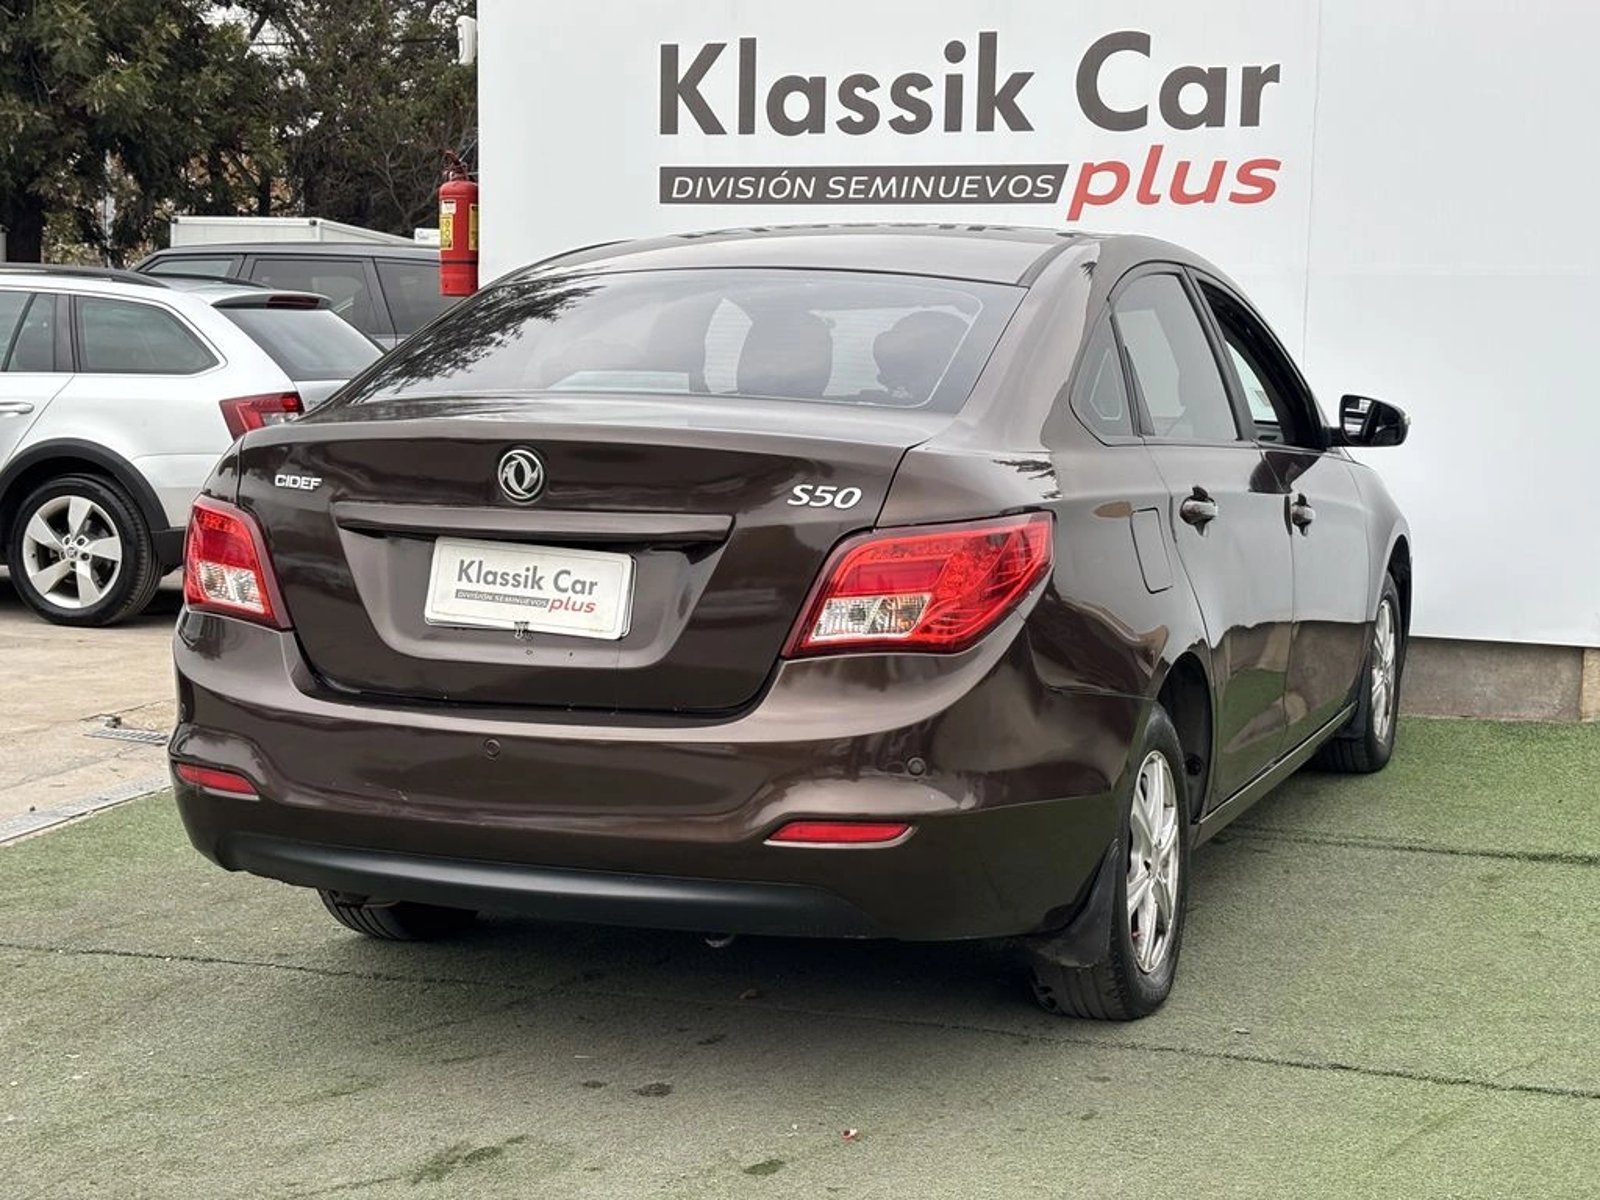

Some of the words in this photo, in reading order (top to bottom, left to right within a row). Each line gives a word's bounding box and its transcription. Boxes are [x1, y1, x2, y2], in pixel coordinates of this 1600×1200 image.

[660, 31, 1035, 136] Klassik
[1076, 30, 1281, 132] Car
[671, 171, 816, 201] DIVISIÓN
[826, 174, 1055, 200] SEMINUEVOS
[1067, 145, 1282, 221] plus
[274, 474, 322, 490] CIDEF
[787, 484, 862, 509] S50
[457, 559, 545, 591] Klassik
[553, 569, 598, 596] Car
[548, 597, 596, 613] plus
